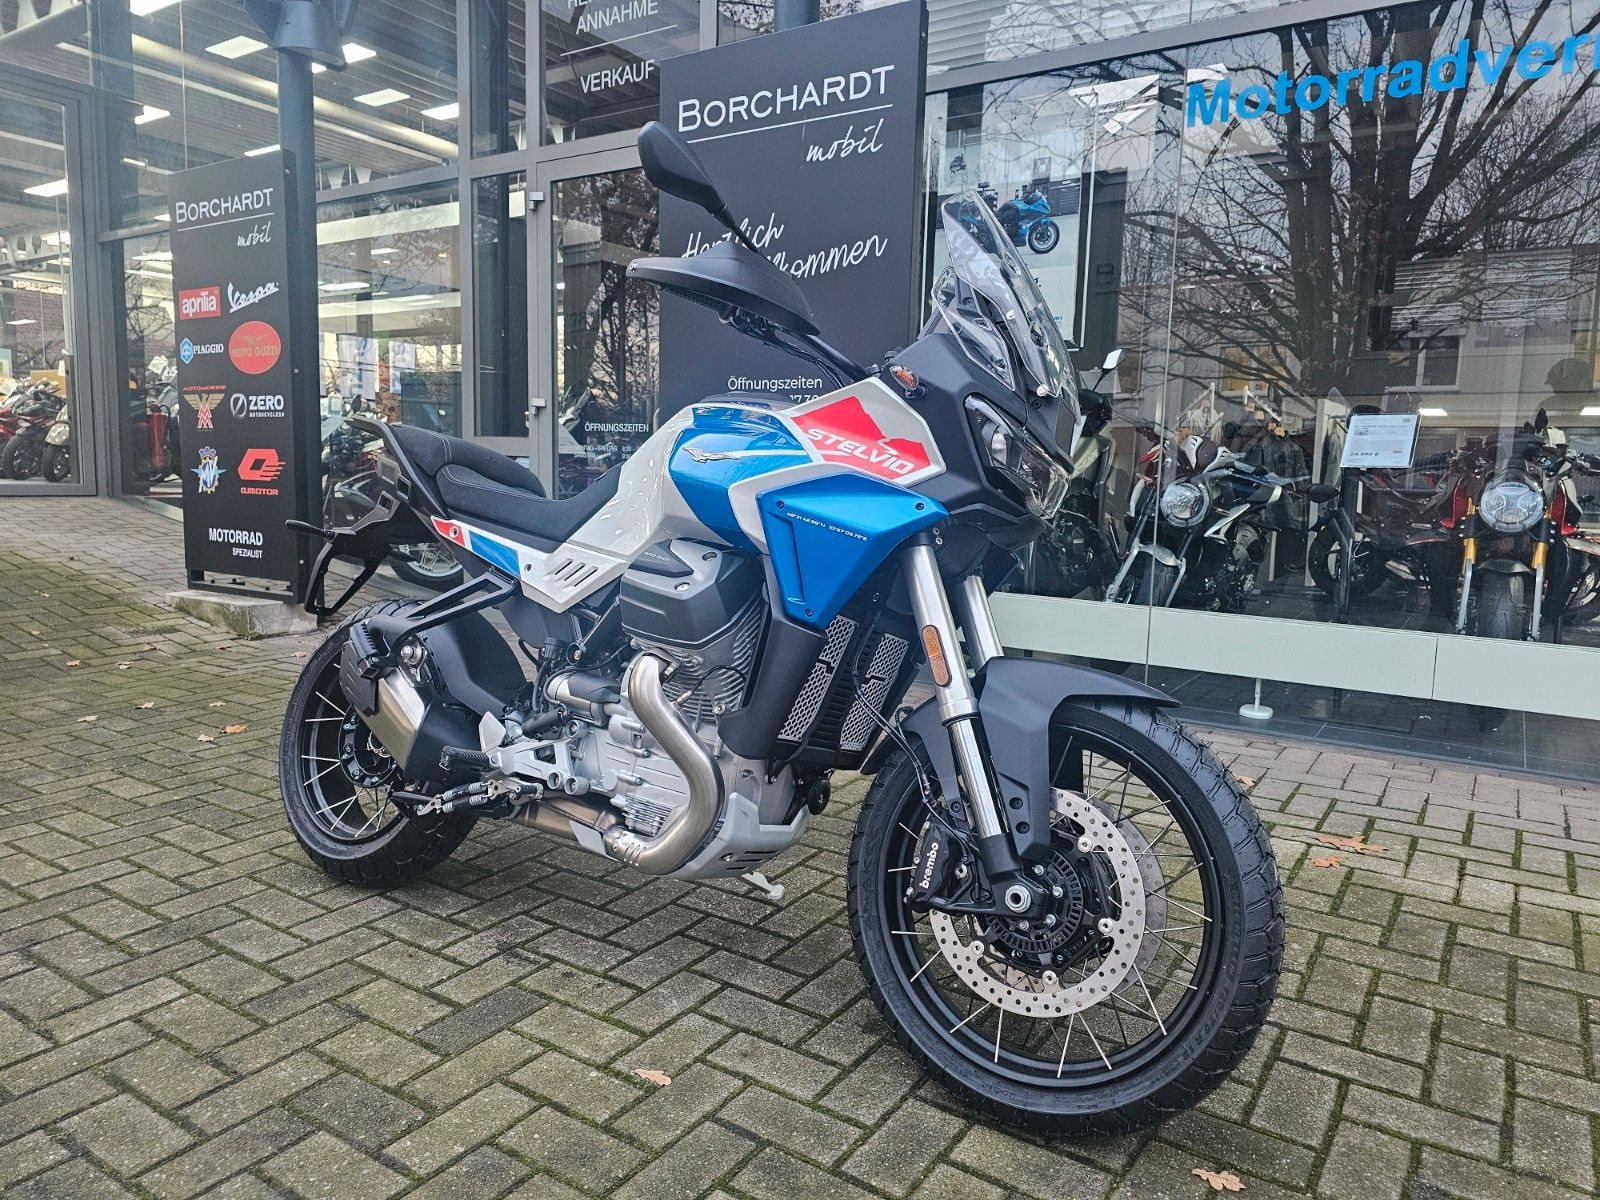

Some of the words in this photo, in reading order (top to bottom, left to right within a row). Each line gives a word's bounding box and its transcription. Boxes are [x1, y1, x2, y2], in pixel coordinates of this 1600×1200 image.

[575, 0, 659, 35] ANNAHME
[580, 59, 656, 94] VERKAUF
[1186, 32, 1600, 128] Motorradver
[678, 64, 895, 133] BORCHARDT
[806, 118, 884, 162] mobil
[175, 187, 274, 224] BORCHARDT
[237, 221, 272, 247] mobil
[182, 291, 217, 317] aprilia
[227, 281, 280, 313] Vespa
[193, 343, 225, 355] PIAGGIO
[231, 347, 252, 358] MOTO
[255, 345, 278, 357] GUZZI
[727, 375, 823, 393] Öffnungszeiten
[248, 394, 285, 411] ZERO
[584, 421, 650, 433] ÖFFNUNGSZEITEN
[807, 428, 915, 475] STELVIO
[208, 528, 263, 545] MOTORRAD
[232, 547, 263, 559] SPEZIALIST
[919, 842, 939, 889] brembo
